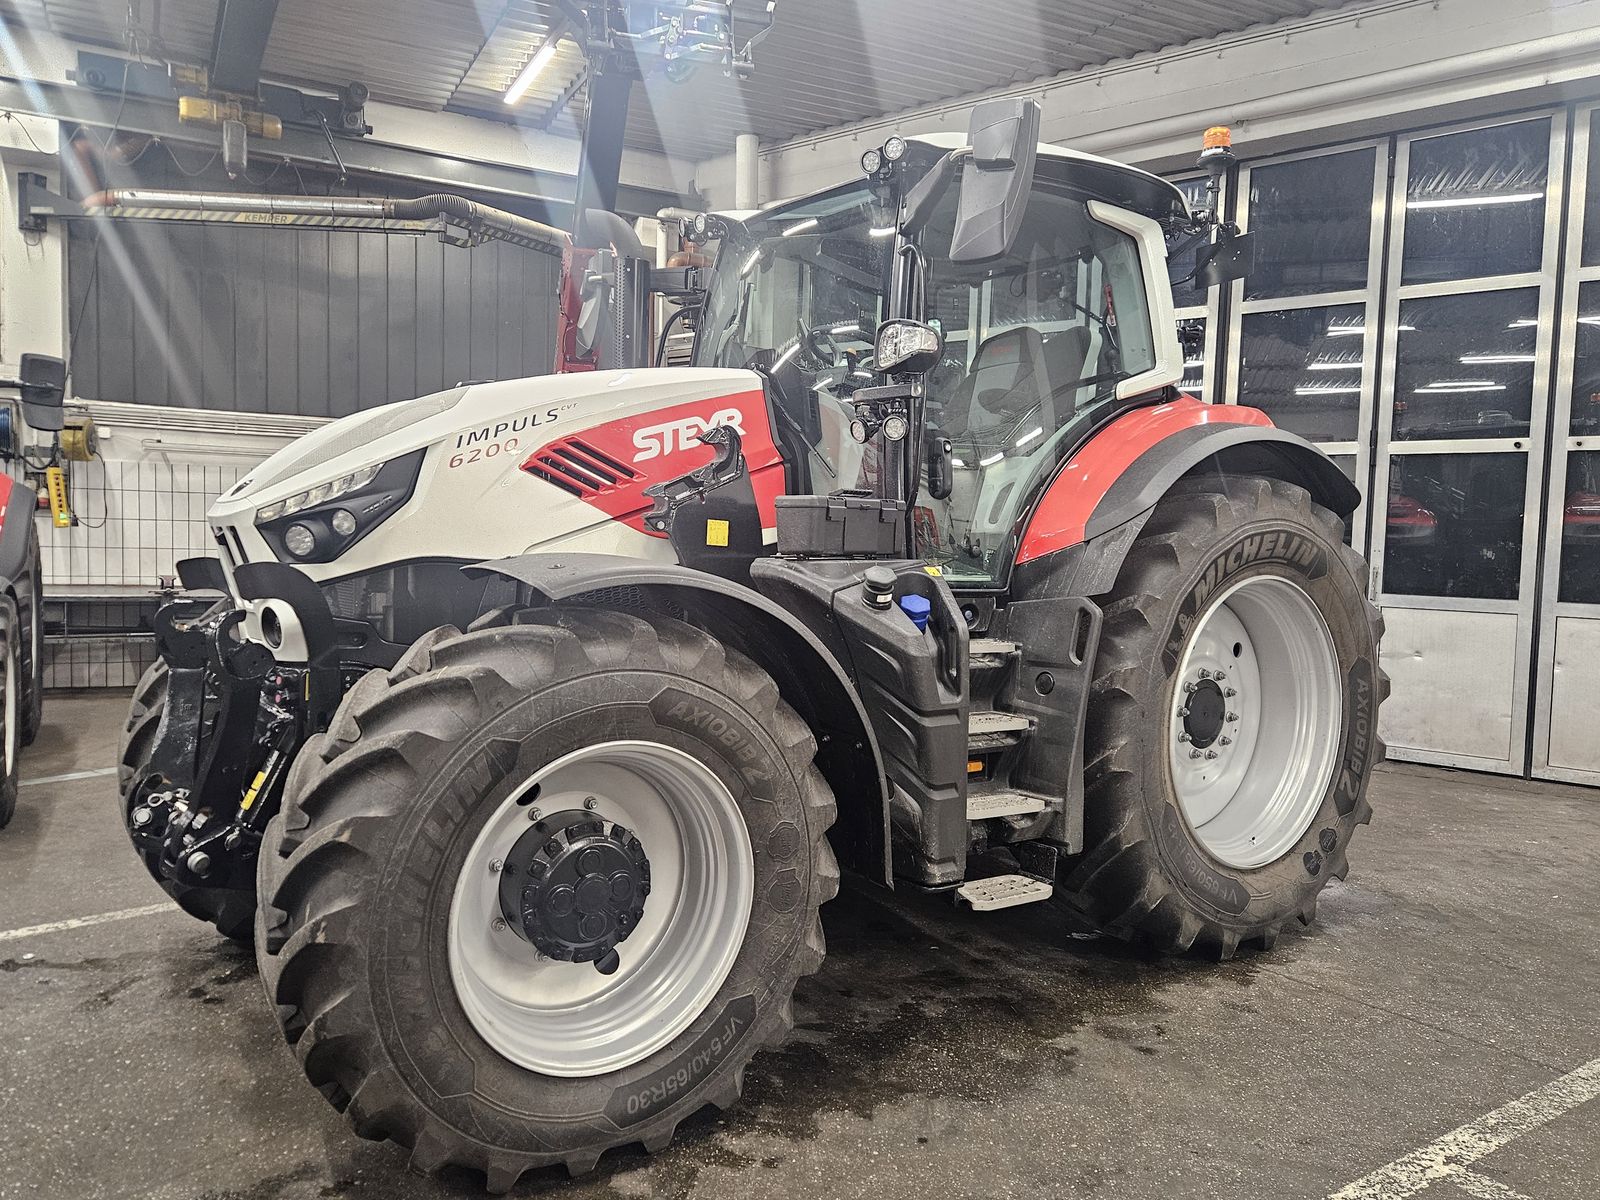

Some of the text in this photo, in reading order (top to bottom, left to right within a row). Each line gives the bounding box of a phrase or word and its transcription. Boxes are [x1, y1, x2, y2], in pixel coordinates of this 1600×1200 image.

[244, 213, 288, 223] KEMPER
[456, 408, 559, 449] IMPULS
[449, 438, 518, 468] 6200
[1194, 532, 1320, 613] MICHELIN
